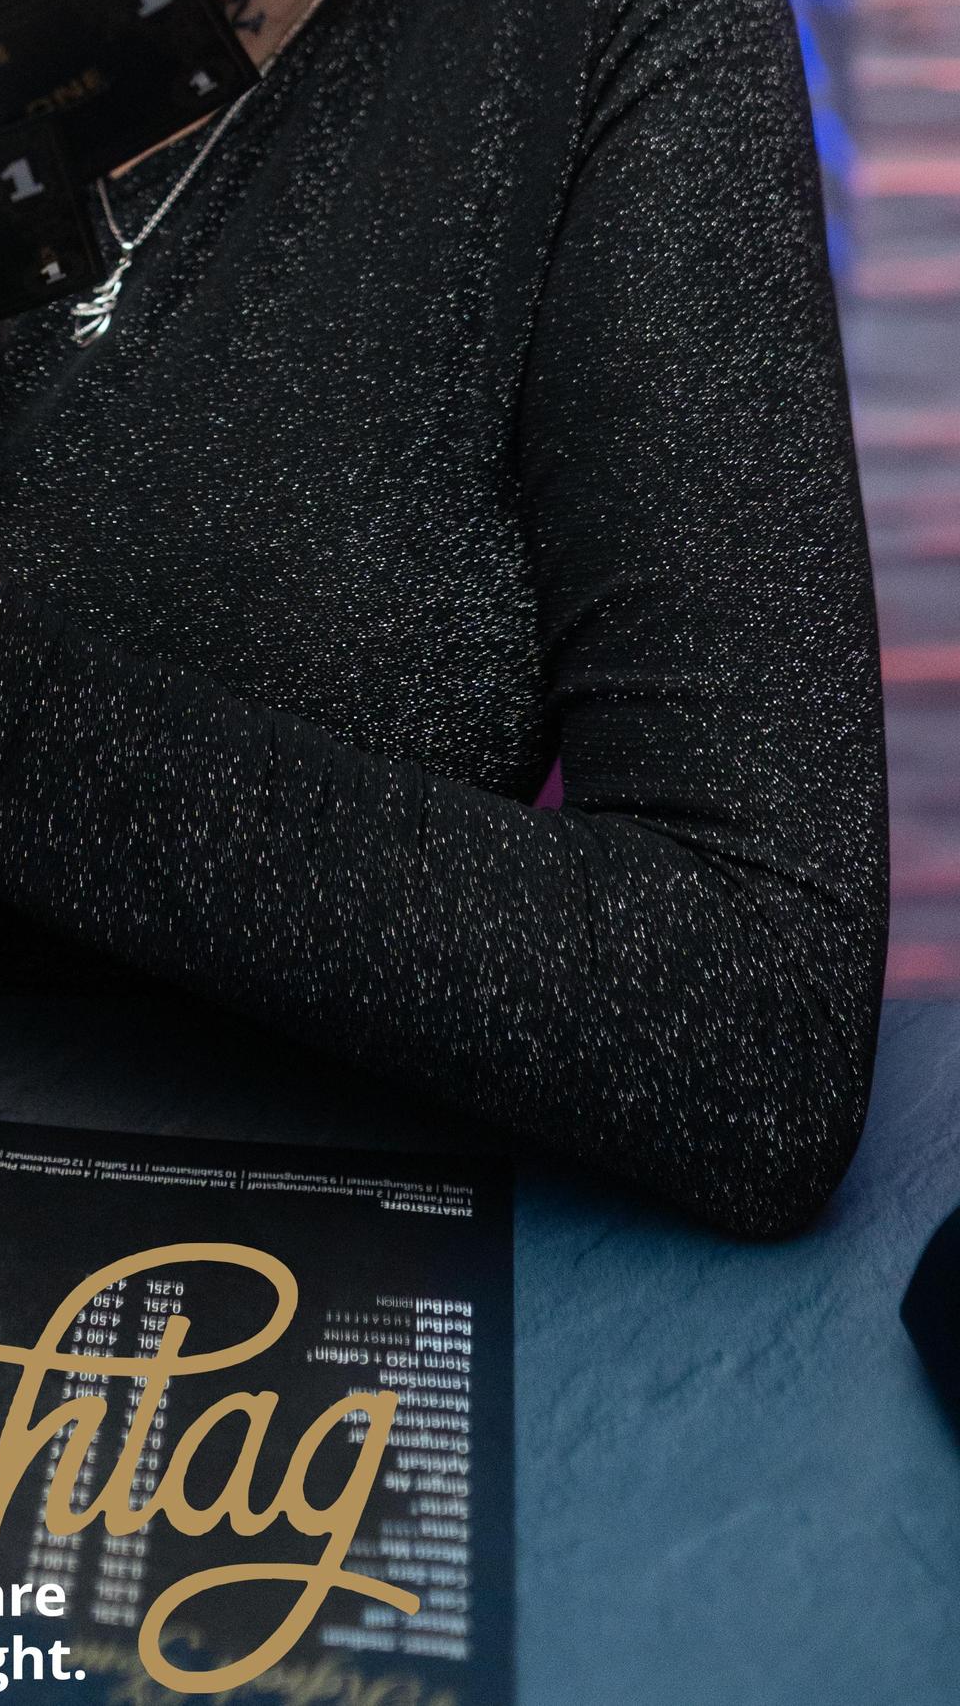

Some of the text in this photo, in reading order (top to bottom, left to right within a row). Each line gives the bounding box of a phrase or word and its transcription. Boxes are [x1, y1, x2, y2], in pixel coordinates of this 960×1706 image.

[188, 70, 218, 96] 1
[0, 158, 44, 202] 1
[41, 261, 68, 285] 1
[6, 1152, 71, 1166] Gerstenmalz
[94, 1161, 127, 1171] Sulfite
[20, 1164, 42, 1173] eine
[45, 1165, 82, 1177] enthält
[152, 1165, 224, 1178] Stabilisatoren
[101, 1172, 207, 1187] Antioxidationsmittel
[210, 1180, 227, 1188] mit
[247, 1181, 353, 1196] Konservierungsstoff
[356, 1188, 373, 1197] mit
[395, 1192, 443, 1204] Farbstoff
[380, 1201, 472, 1217] ZUSATZSSTOFFE:
[146, 1281, 184, 1296] 0.25L
[143, 1298, 181, 1314] 0.25L
[90, 1311, 120, 1327] 4.50
[73, 1327, 118, 1345] 4.00 €
[323, 1329, 410, 1345] ENERGY DRINK
[315, 1346, 368, 1365] Coffein
[386, 1351, 419, 1369] H2O
[424, 1355, 470, 1373] Storm
[379, 1371, 470, 1393] LemonSoda
